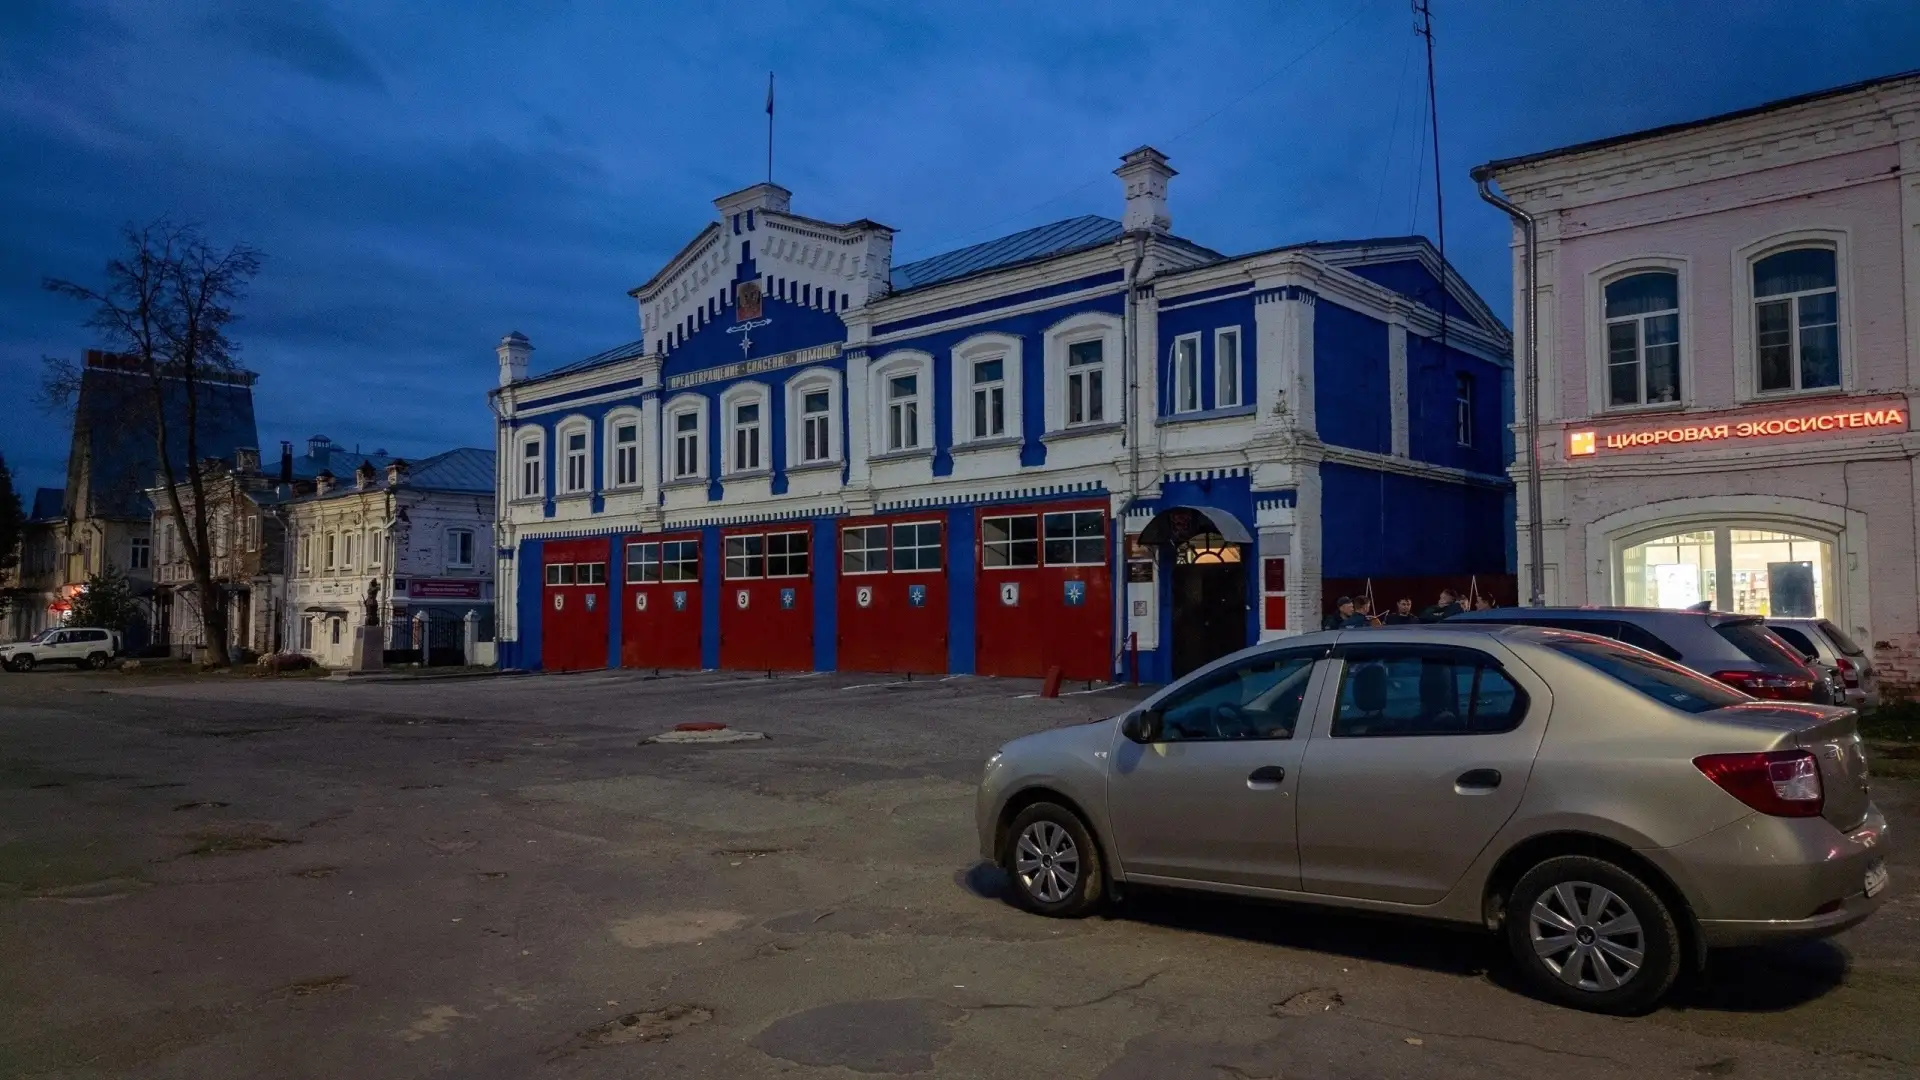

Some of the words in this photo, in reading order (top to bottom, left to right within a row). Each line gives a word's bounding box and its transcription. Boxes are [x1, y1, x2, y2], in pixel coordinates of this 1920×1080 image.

[671, 364, 740, 389] ПРЕДОТВРАЩЕНИЕ
[746, 354, 789, 373] СПАСЕНИЕ
[796, 345, 837, 363] ПОМОЩЬ
[1607, 424, 1728, 449] ЦИФРОВАЯ
[1736, 409, 1903, 437] ЭКОСИСТЕМА
[860, 591, 868, 603] 2
